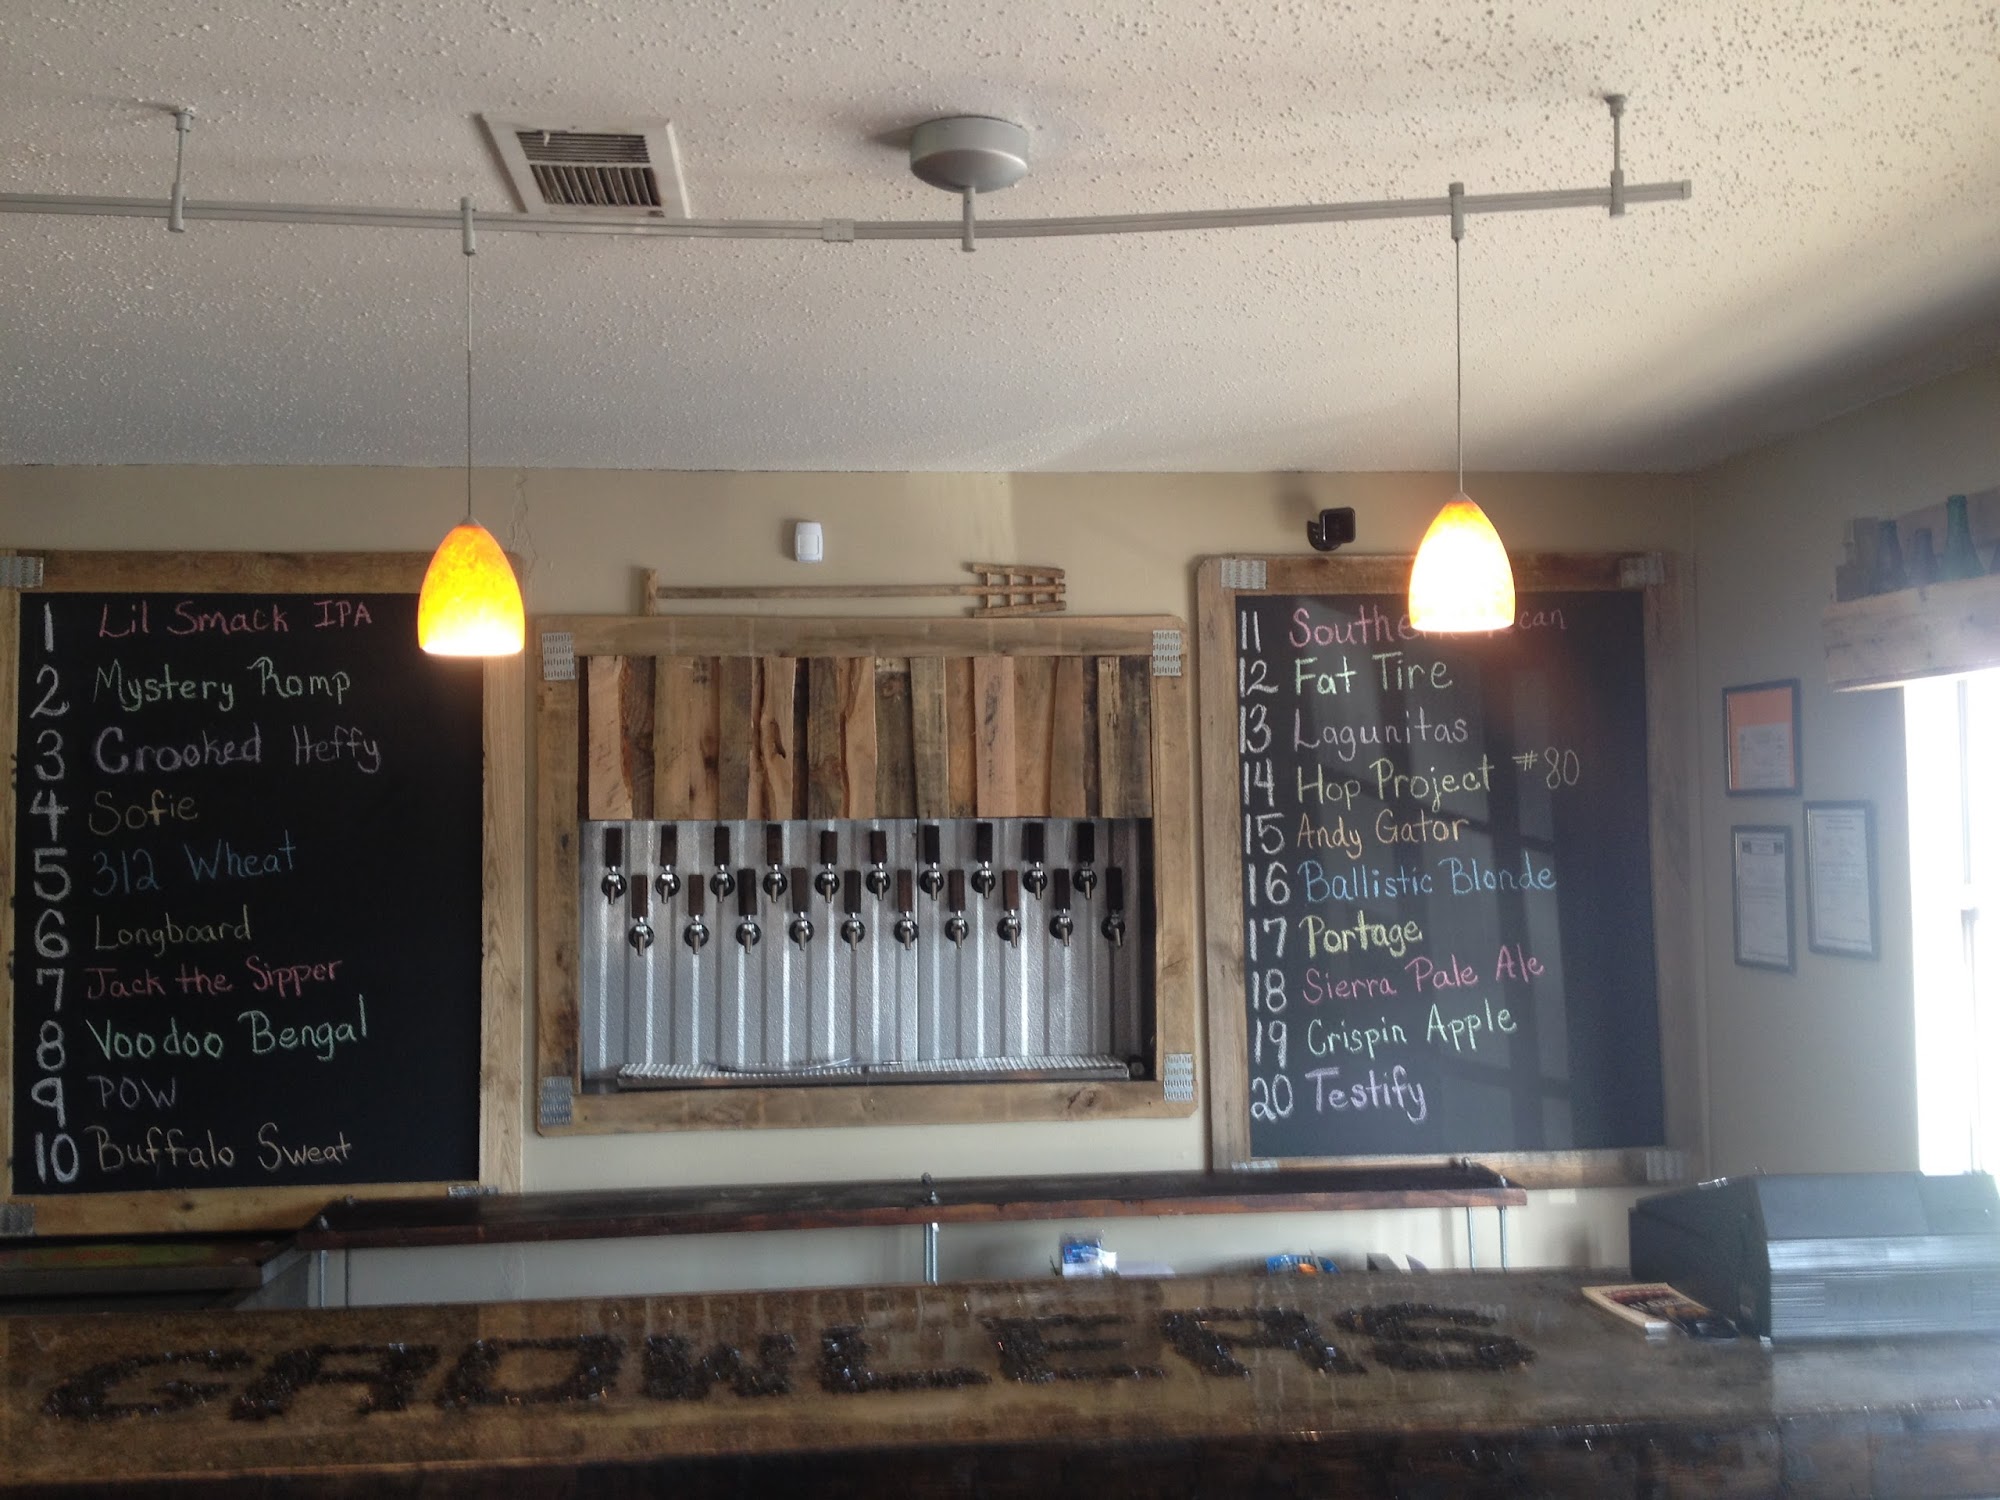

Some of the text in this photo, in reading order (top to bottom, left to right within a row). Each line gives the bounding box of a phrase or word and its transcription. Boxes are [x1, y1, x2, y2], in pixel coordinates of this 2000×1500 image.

[44, 599, 373, 652] 1 Lil Smack IPA
[1240, 611, 1261, 652] 11
[30, 665, 70, 719] 2
[93, 657, 236, 712] Mystery
[1239, 652, 1454, 698] 12 Fat Tire
[34, 722, 382, 781] 3 Crooked Heffy
[1239, 704, 1469, 762] 13 Lagunitas
[1242, 758, 1275, 807] 14
[1297, 763, 1362, 811] Hop
[1368, 753, 1496, 812] Project
[30, 790, 199, 842] 4 Sofie
[1245, 808, 1470, 861] 15 Andy Gator
[34, 829, 297, 901] 5 312 Wheat
[1248, 849, 1558, 906] 16 Ballistic Blonde
[33, 904, 252, 960] 6 Longboard
[1249, 909, 1424, 961] 17 Portage
[36, 956, 343, 1012] 7 Jack the Sipper
[1252, 944, 1545, 1014] 18 Sierra Pale Ale
[36, 994, 368, 1071] 8 Voodoo Bengal
[1253, 997, 1518, 1069] 19 Crispin Apple
[31, 1076, 176, 1127] 9 POW
[1250, 1064, 1428, 1123] 20 Testify
[34, 1122, 352, 1184] 10 Buffalo Sweat
